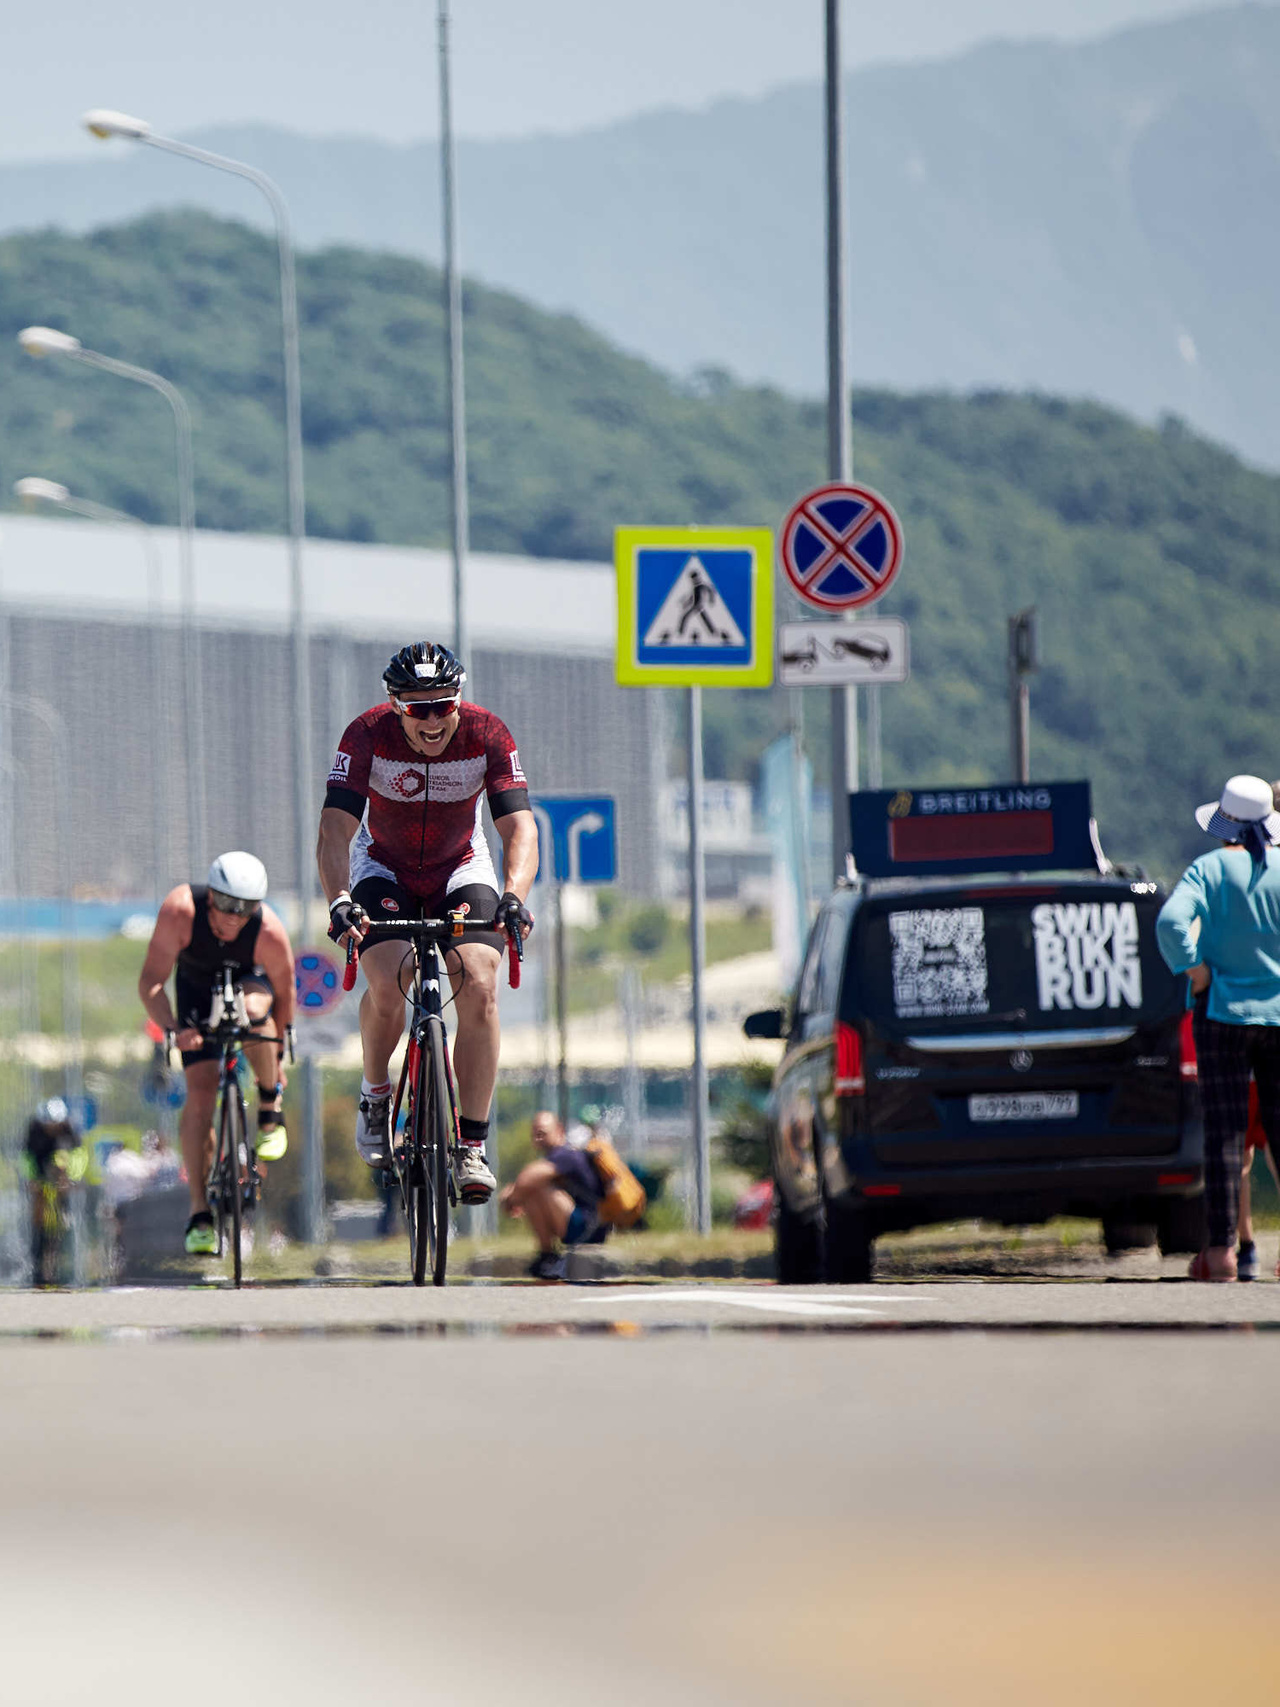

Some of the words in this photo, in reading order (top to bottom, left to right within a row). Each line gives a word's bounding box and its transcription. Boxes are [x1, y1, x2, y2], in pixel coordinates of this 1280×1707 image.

[920, 789, 1052, 814] BREITLING
[1031, 902, 1139, 938] SWIM
[1035, 935, 1139, 969] BIKE
[1038, 958, 1142, 1011] RUN
